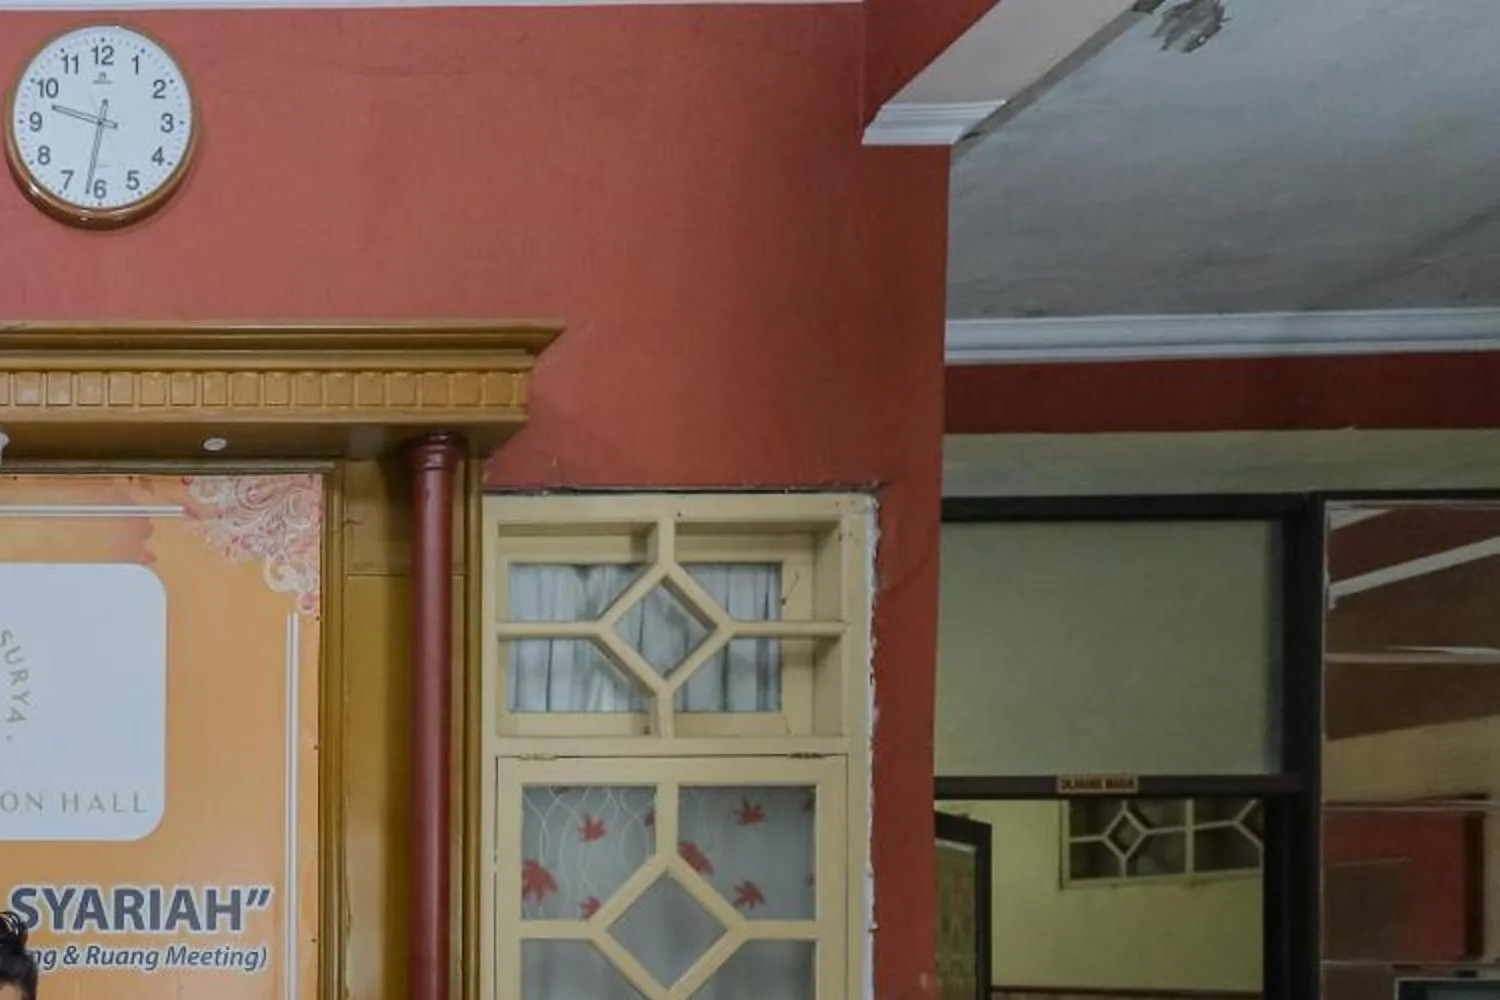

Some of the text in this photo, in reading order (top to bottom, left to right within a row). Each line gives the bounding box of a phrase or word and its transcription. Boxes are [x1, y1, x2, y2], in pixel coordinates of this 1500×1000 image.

[61, 54, 79, 74] 11
[91, 45, 114, 66] 12
[131, 55, 139, 75] 1
[36, 78, 59, 98] 10
[152, 79, 166, 99] 2
[29, 112, 43, 132] 9
[160, 113, 174, 133] 3
[37, 145, 51, 165] 8
[151, 147, 164, 166] 4
[61, 169, 74, 190] 7
[93, 179, 107, 199] 6
[126, 170, 140, 190] 5
[60, 792, 148, 813] HALL
[10, 886, 272, 932] SYARIAH”
[63, 945, 81, 965] &
[86, 945, 159, 971] Ruang
[165, 945, 268, 971] Meeting)
